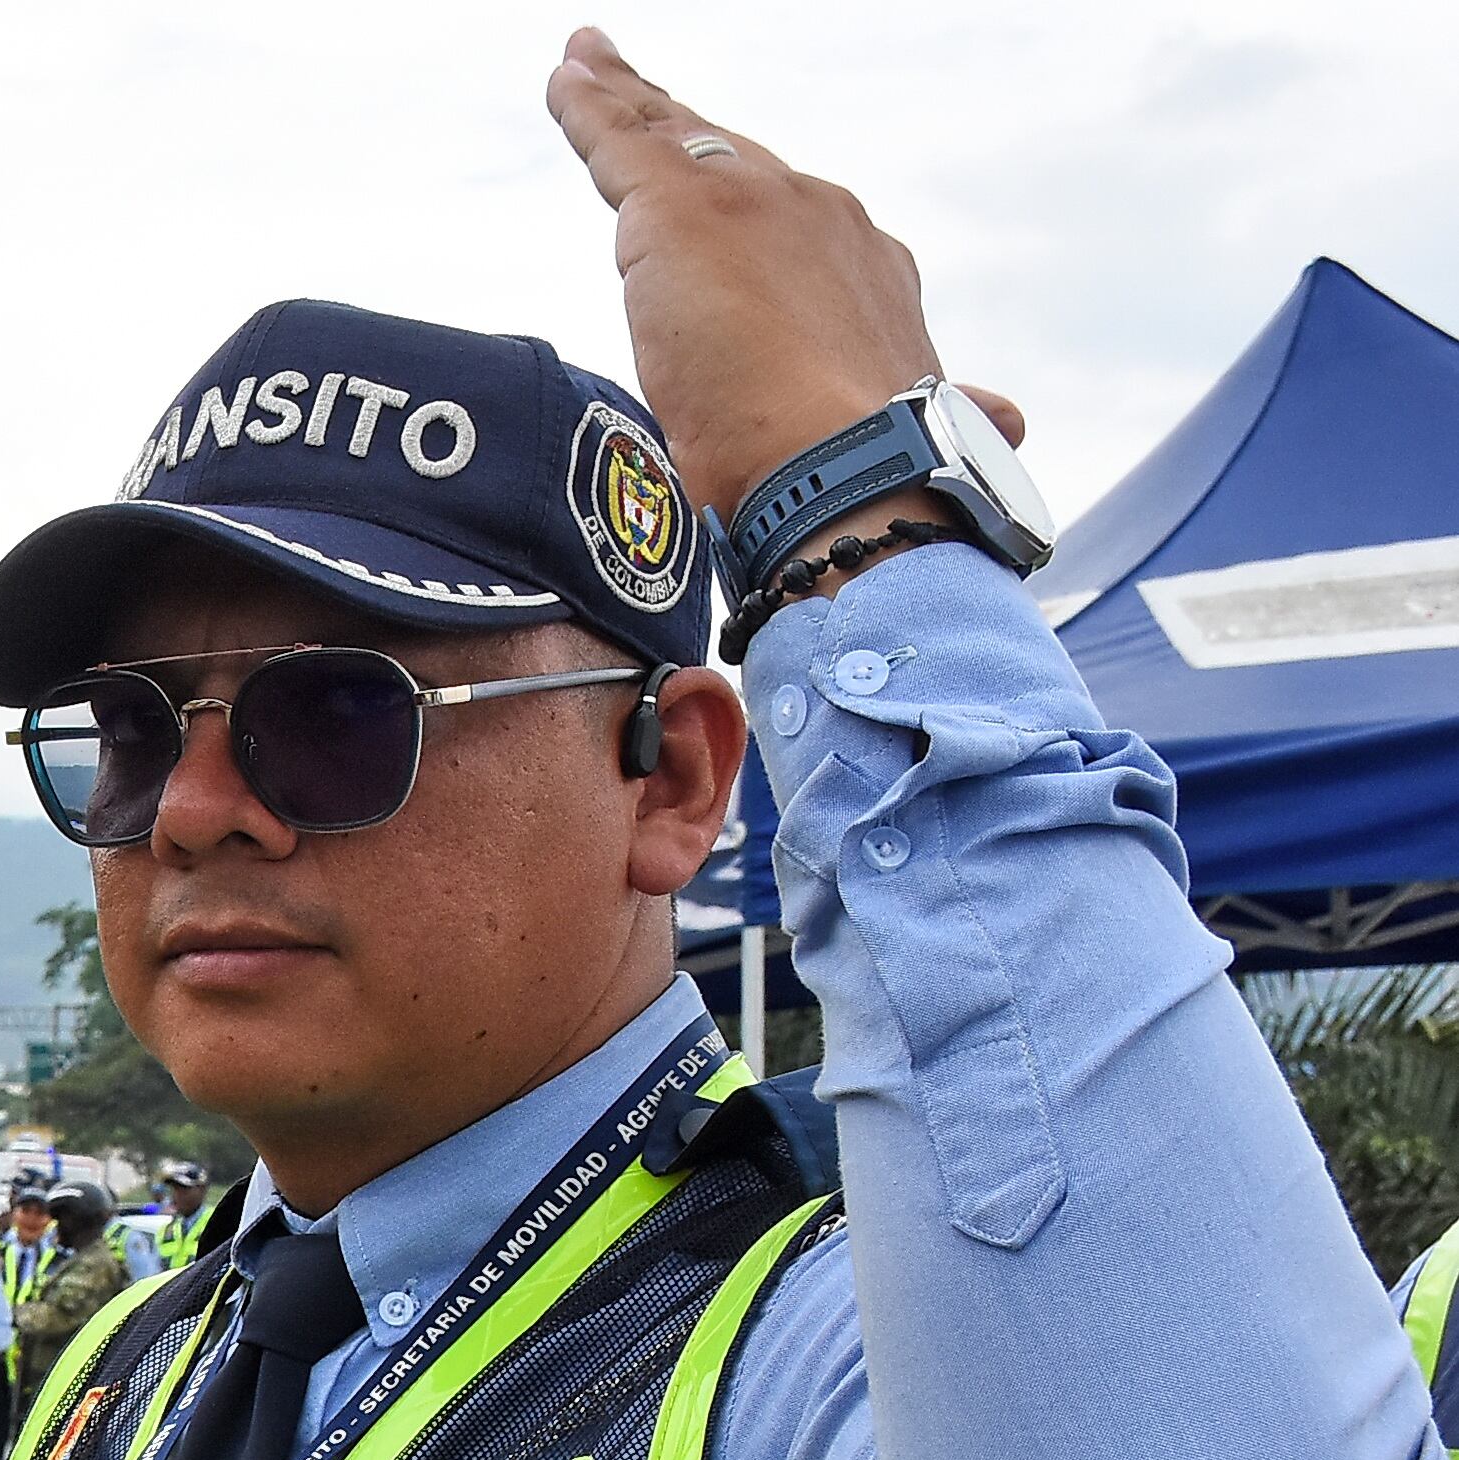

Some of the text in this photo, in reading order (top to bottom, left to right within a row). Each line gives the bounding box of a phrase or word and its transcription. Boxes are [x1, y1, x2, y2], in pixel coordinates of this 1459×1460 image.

[584, 516, 679, 604] DE COLOMBIA
[359, 1295, 476, 1414] SECRETARÍA
[469, 1262, 504, 1294] DE
[497, 1152, 608, 1266] MOVILIDAD
[616, 1069, 686, 1144] AGENTE
[677, 1048, 708, 1078] DE
